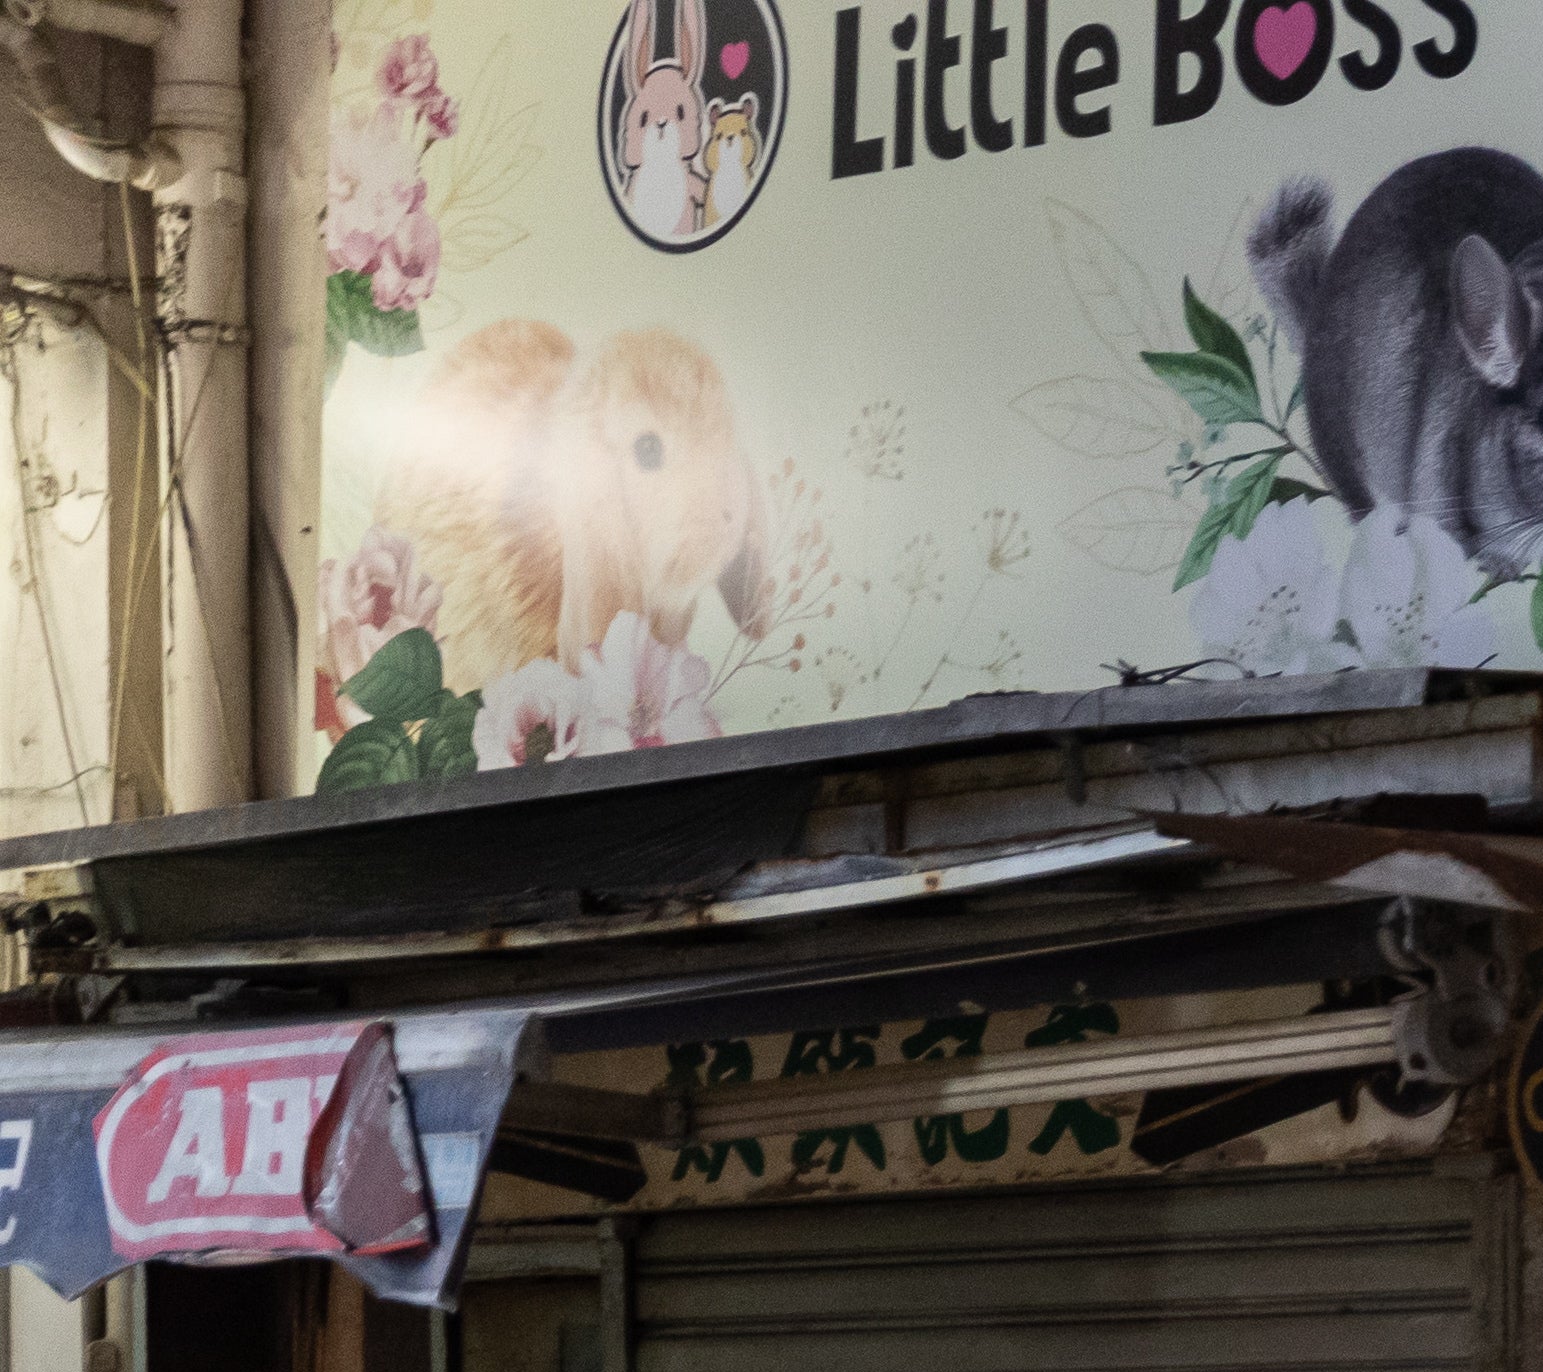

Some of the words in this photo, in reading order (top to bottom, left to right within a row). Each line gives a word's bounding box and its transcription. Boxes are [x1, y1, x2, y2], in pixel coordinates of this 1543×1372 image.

[830, 0, 1121, 180] Little
[1152, 0, 1478, 127] Boss
[146, 1074, 338, 1205] AB
